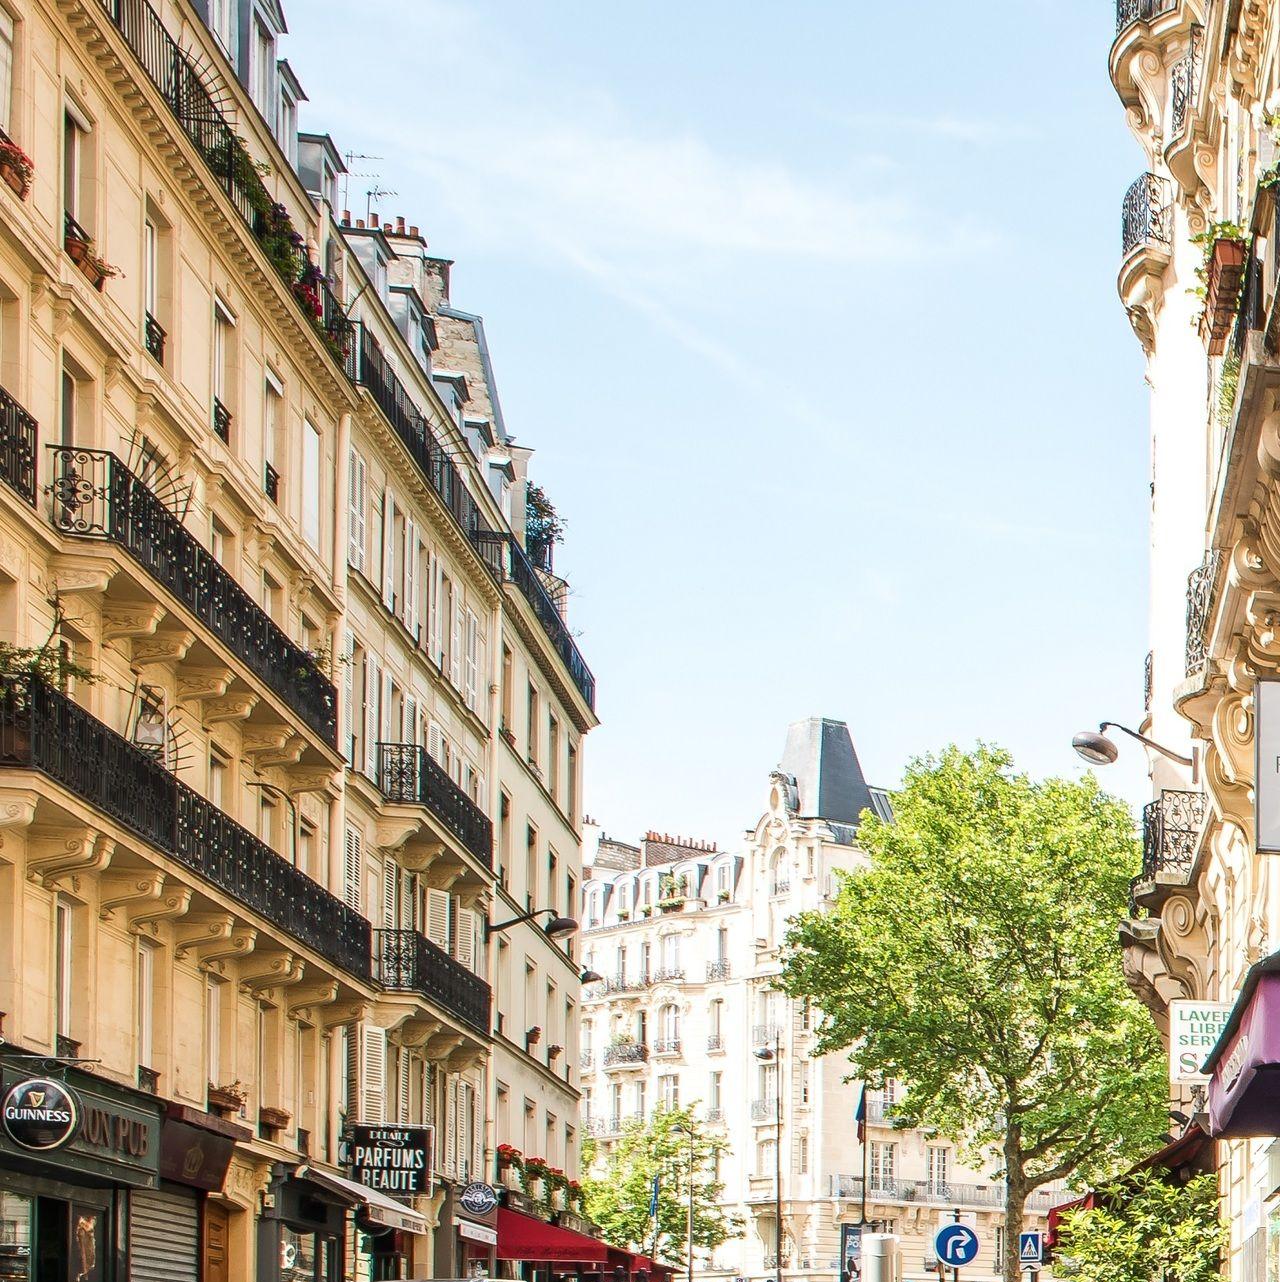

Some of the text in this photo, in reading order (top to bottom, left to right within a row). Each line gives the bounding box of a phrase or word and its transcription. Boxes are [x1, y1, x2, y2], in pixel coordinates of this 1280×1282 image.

[5, 1106, 71, 1123] GUINNESS
[115, 1114, 150, 1157] PUB
[355, 1146, 424, 1169] PARFUMS
[362, 1169, 417, 1191] BEAUTE
